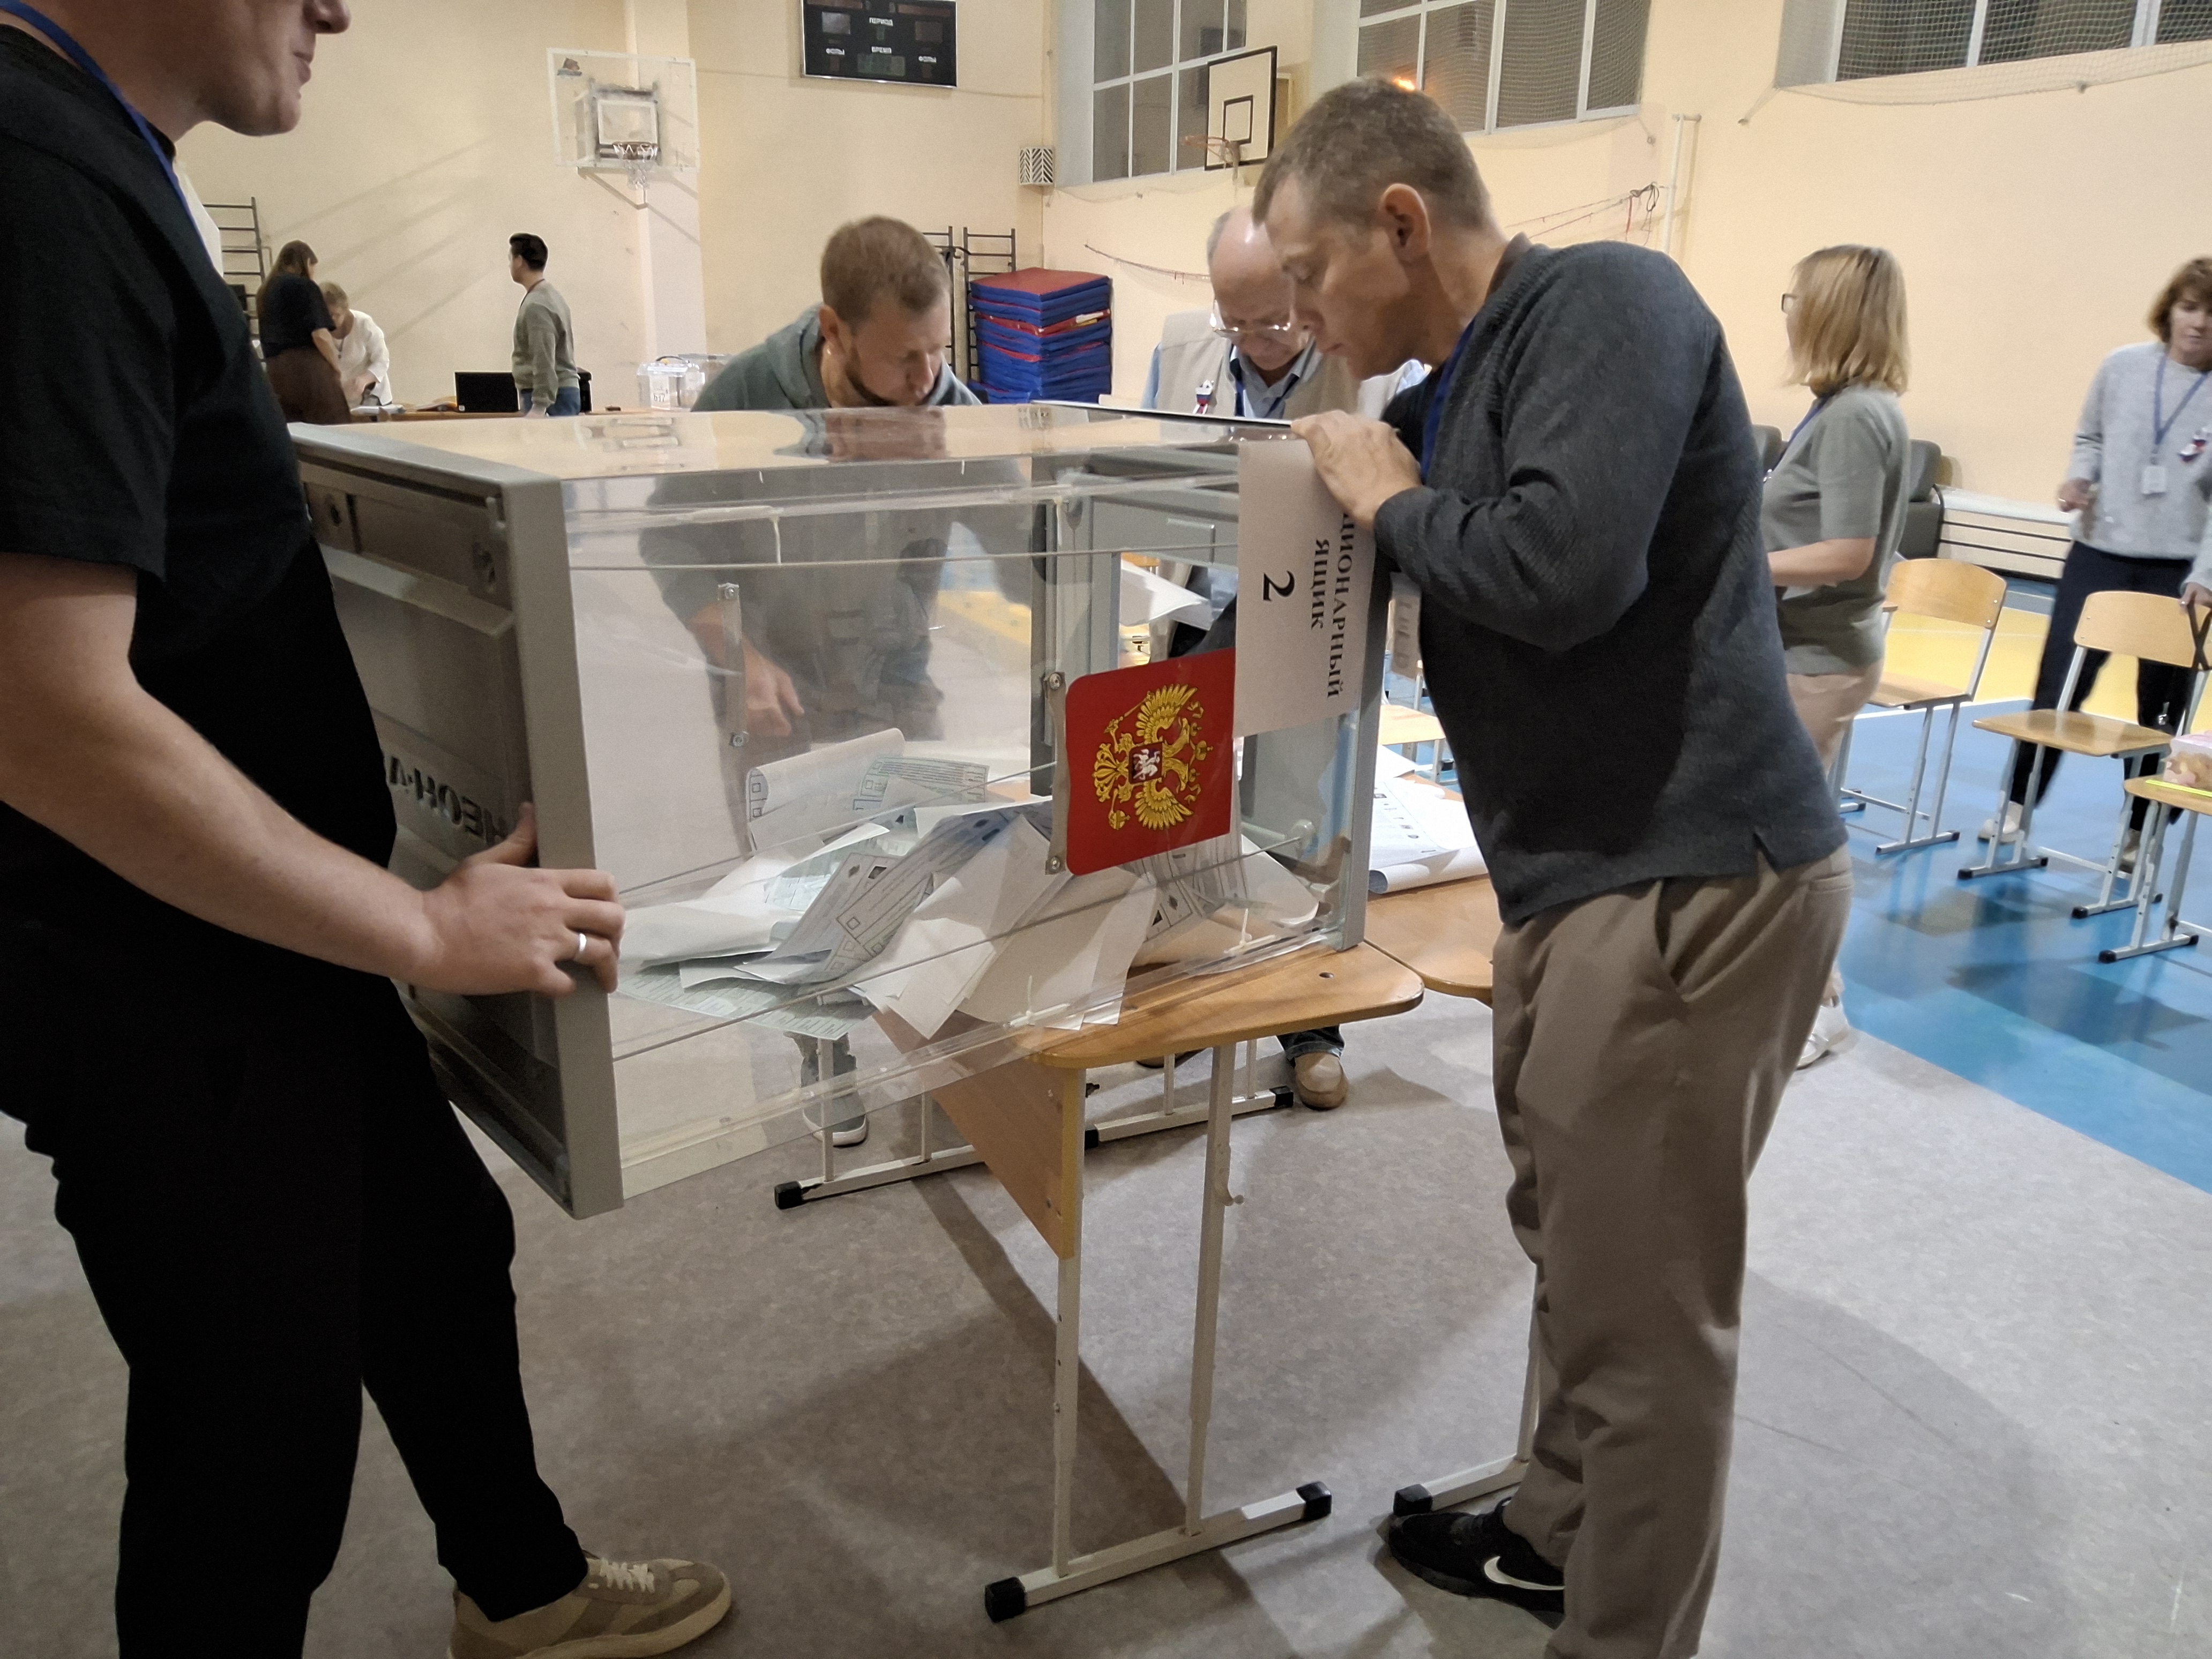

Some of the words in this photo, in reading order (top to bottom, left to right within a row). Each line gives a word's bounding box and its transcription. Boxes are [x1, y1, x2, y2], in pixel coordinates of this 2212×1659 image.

[1262, 571, 1295, 602] 2
[1311, 539, 1330, 630] ЯЩИК
[1327, 513, 1355, 698] ЦИОНАРНЫЙ
